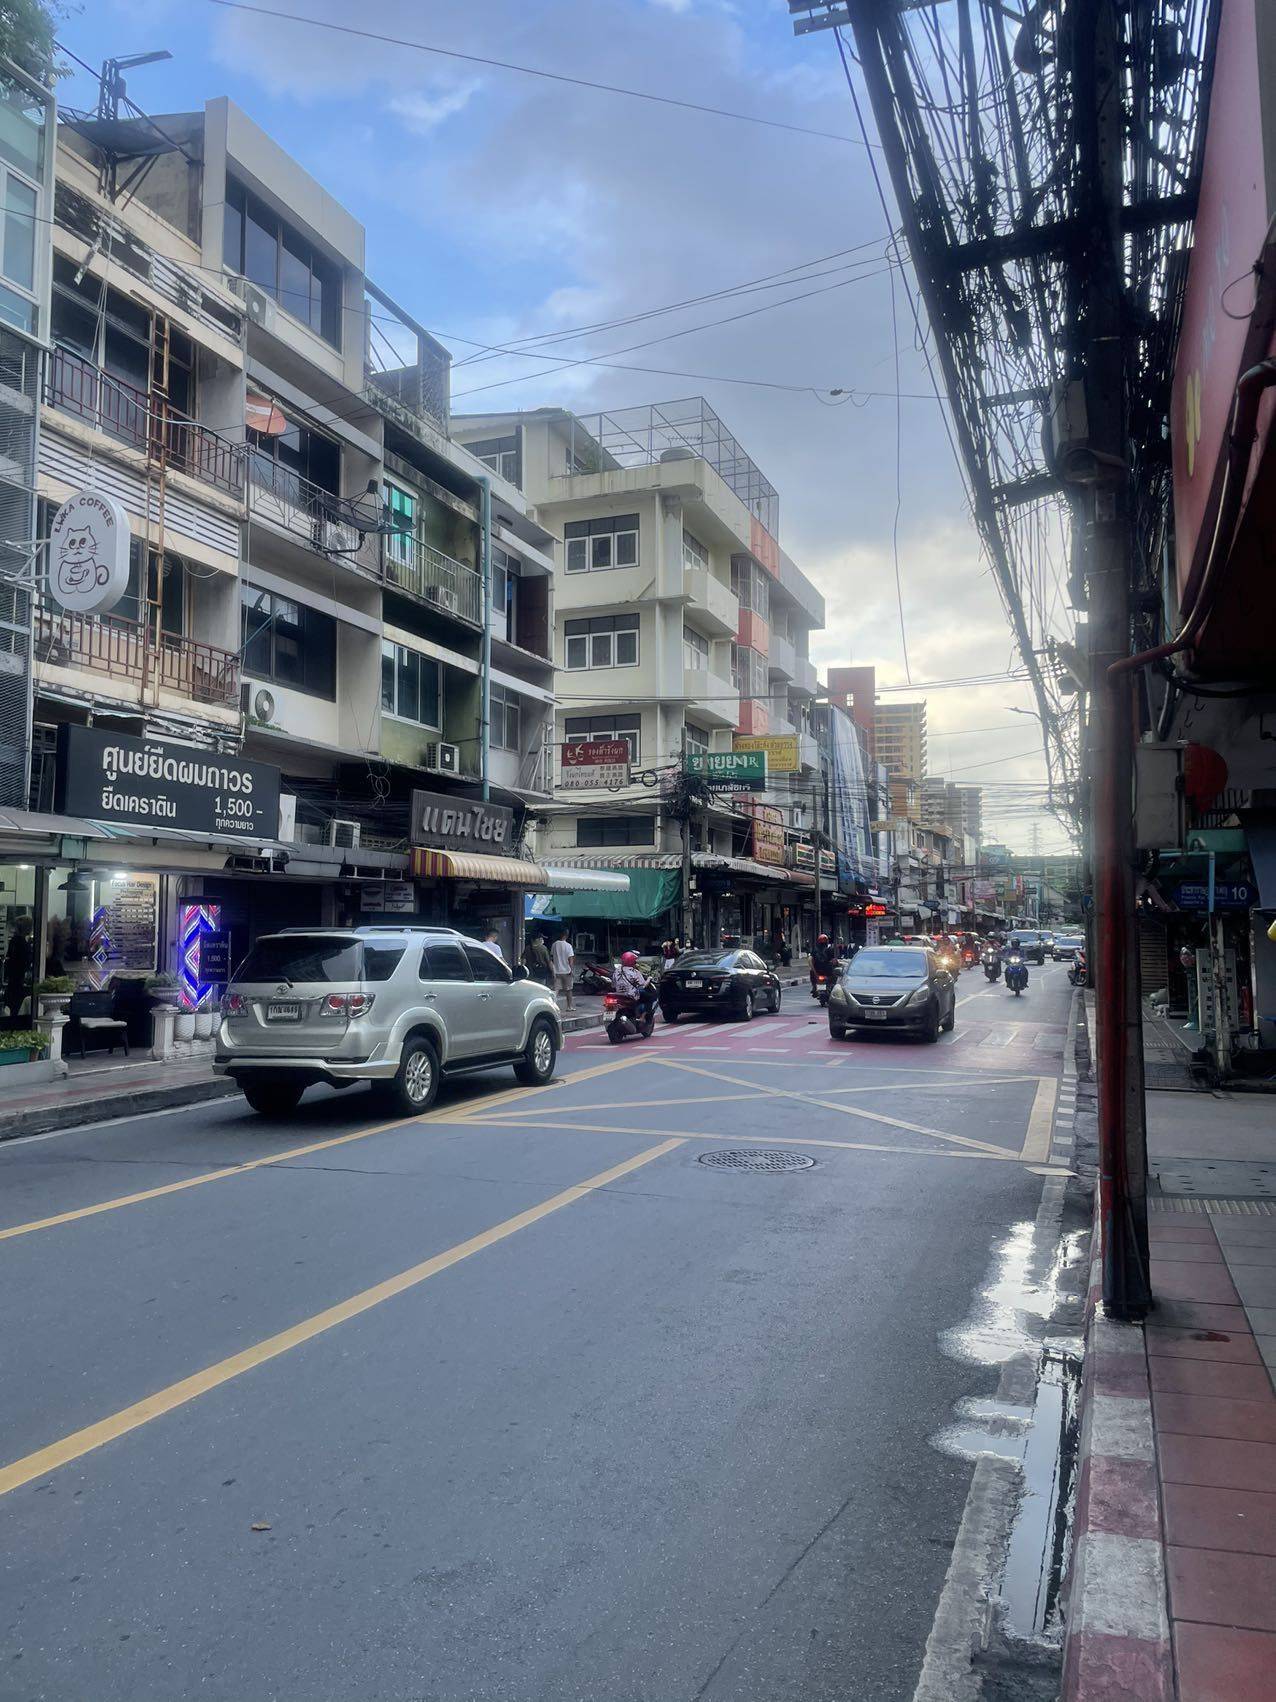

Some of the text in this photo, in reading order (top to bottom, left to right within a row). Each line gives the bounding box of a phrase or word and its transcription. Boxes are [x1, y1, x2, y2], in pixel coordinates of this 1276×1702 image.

[80, 498, 114, 527] COFFEE
[102, 745, 253, 794] ศูนย์ยืดผมถาวร
[692, 755, 748, 770] ขายยา
[101, 785, 176, 818] ยืดเคราติน
[214, 796, 253, 817] 1,500
[215, 817, 254, 831] ทุกความยาว
[1232, 886, 1248, 900] 10
